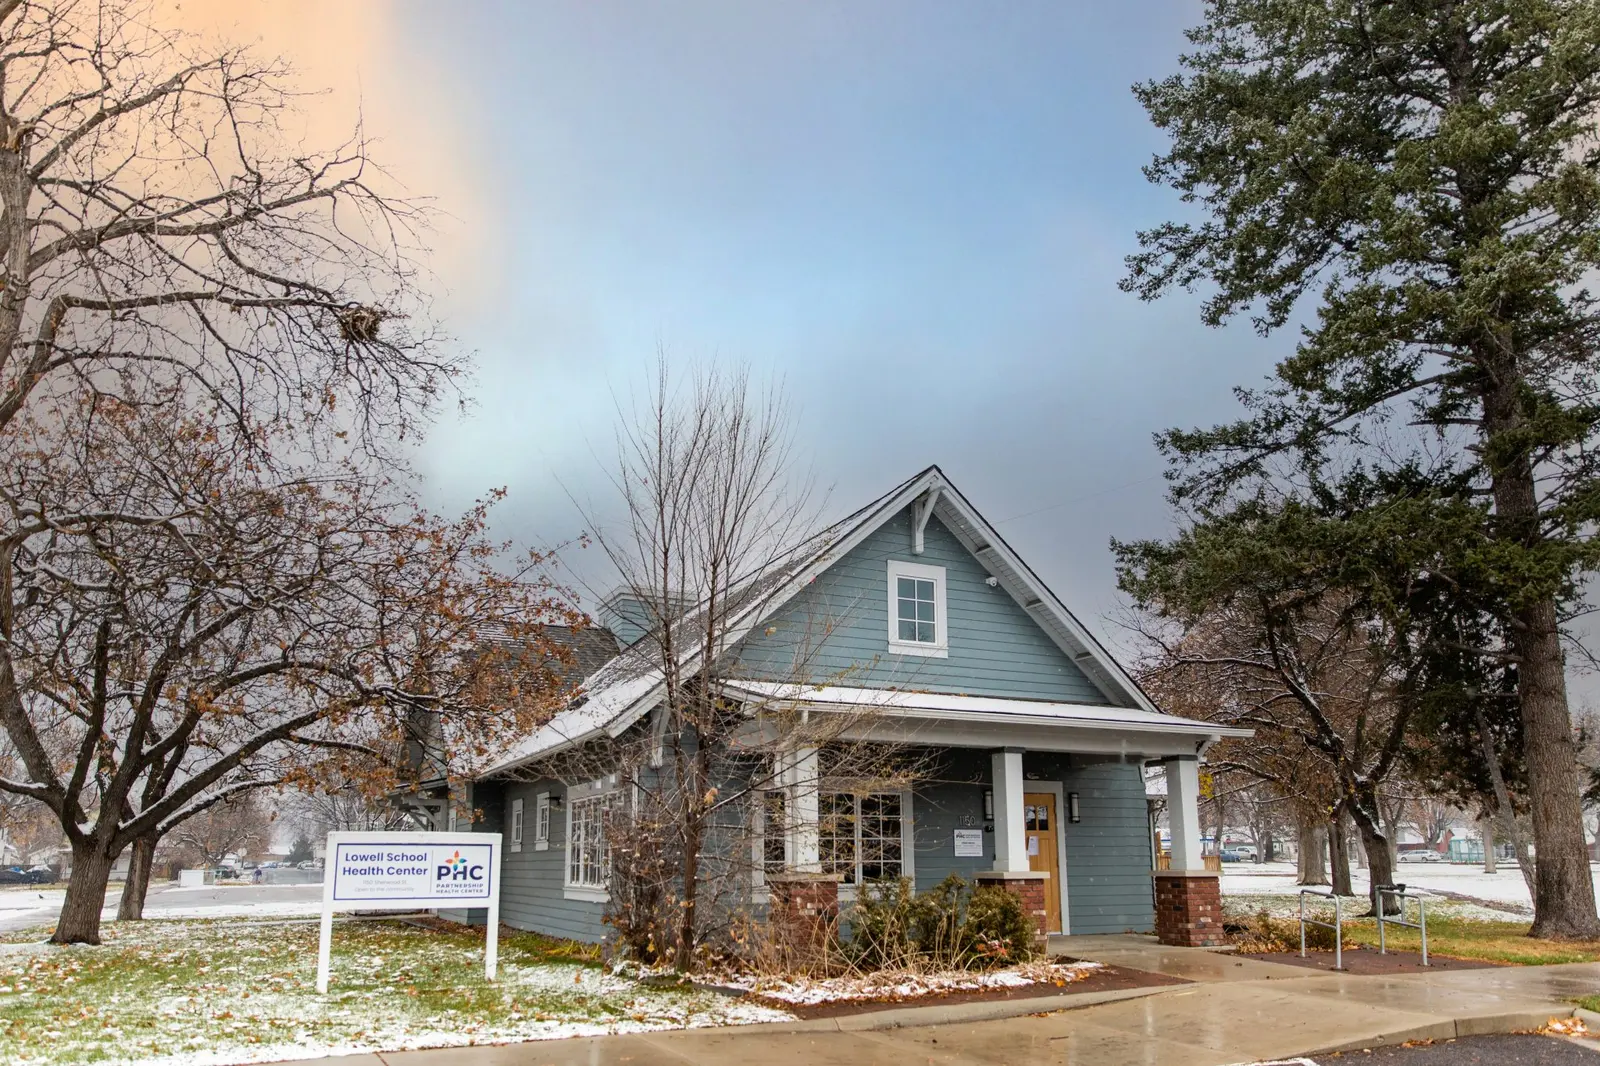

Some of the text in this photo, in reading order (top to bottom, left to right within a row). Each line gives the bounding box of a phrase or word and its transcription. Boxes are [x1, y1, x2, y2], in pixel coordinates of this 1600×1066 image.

[345, 852, 427, 862] Lowell School
[342, 866, 428, 876] Health Center
[437, 865, 484, 881] PHC
